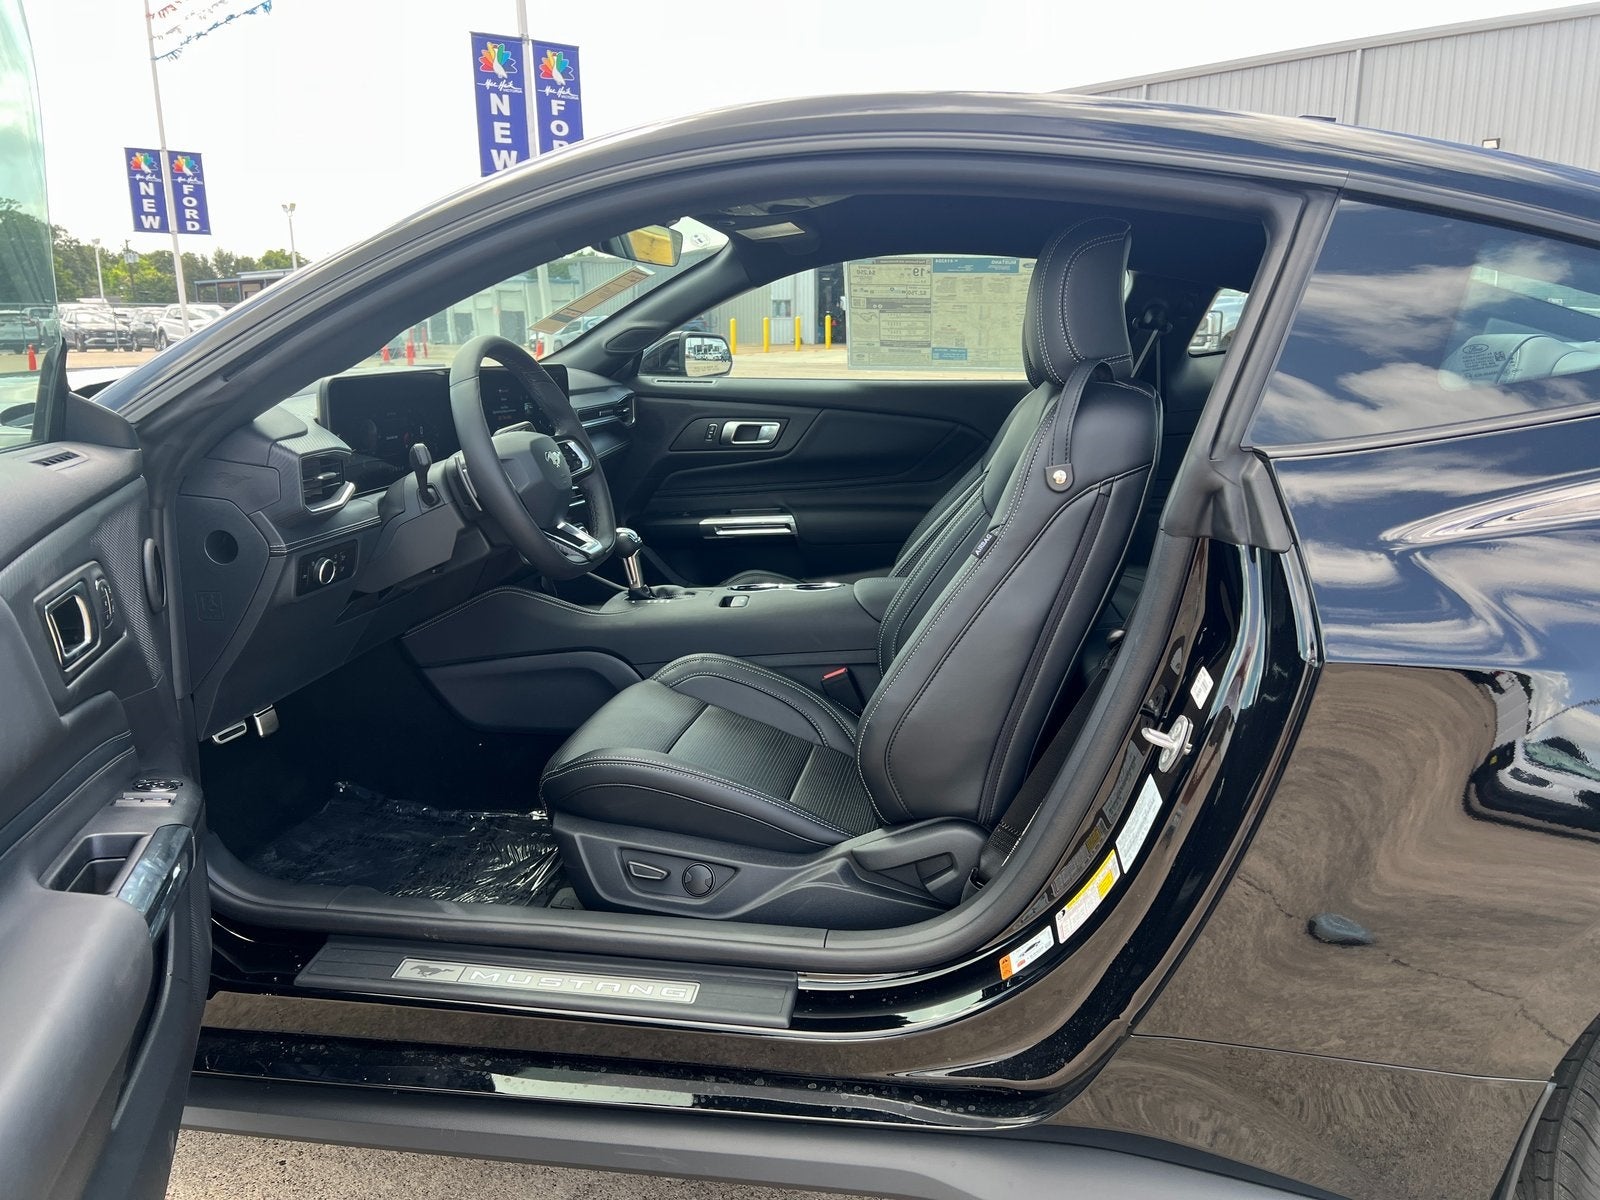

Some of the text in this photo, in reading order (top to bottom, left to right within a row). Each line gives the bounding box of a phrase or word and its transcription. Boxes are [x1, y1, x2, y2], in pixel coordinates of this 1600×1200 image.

[490, 93, 517, 171] NEW
[138, 182, 161, 229] NEW
[182, 185, 200, 231] FORD
[975, 533, 992, 556] AIRBAG
[469, 971, 689, 998] MUSTANG
